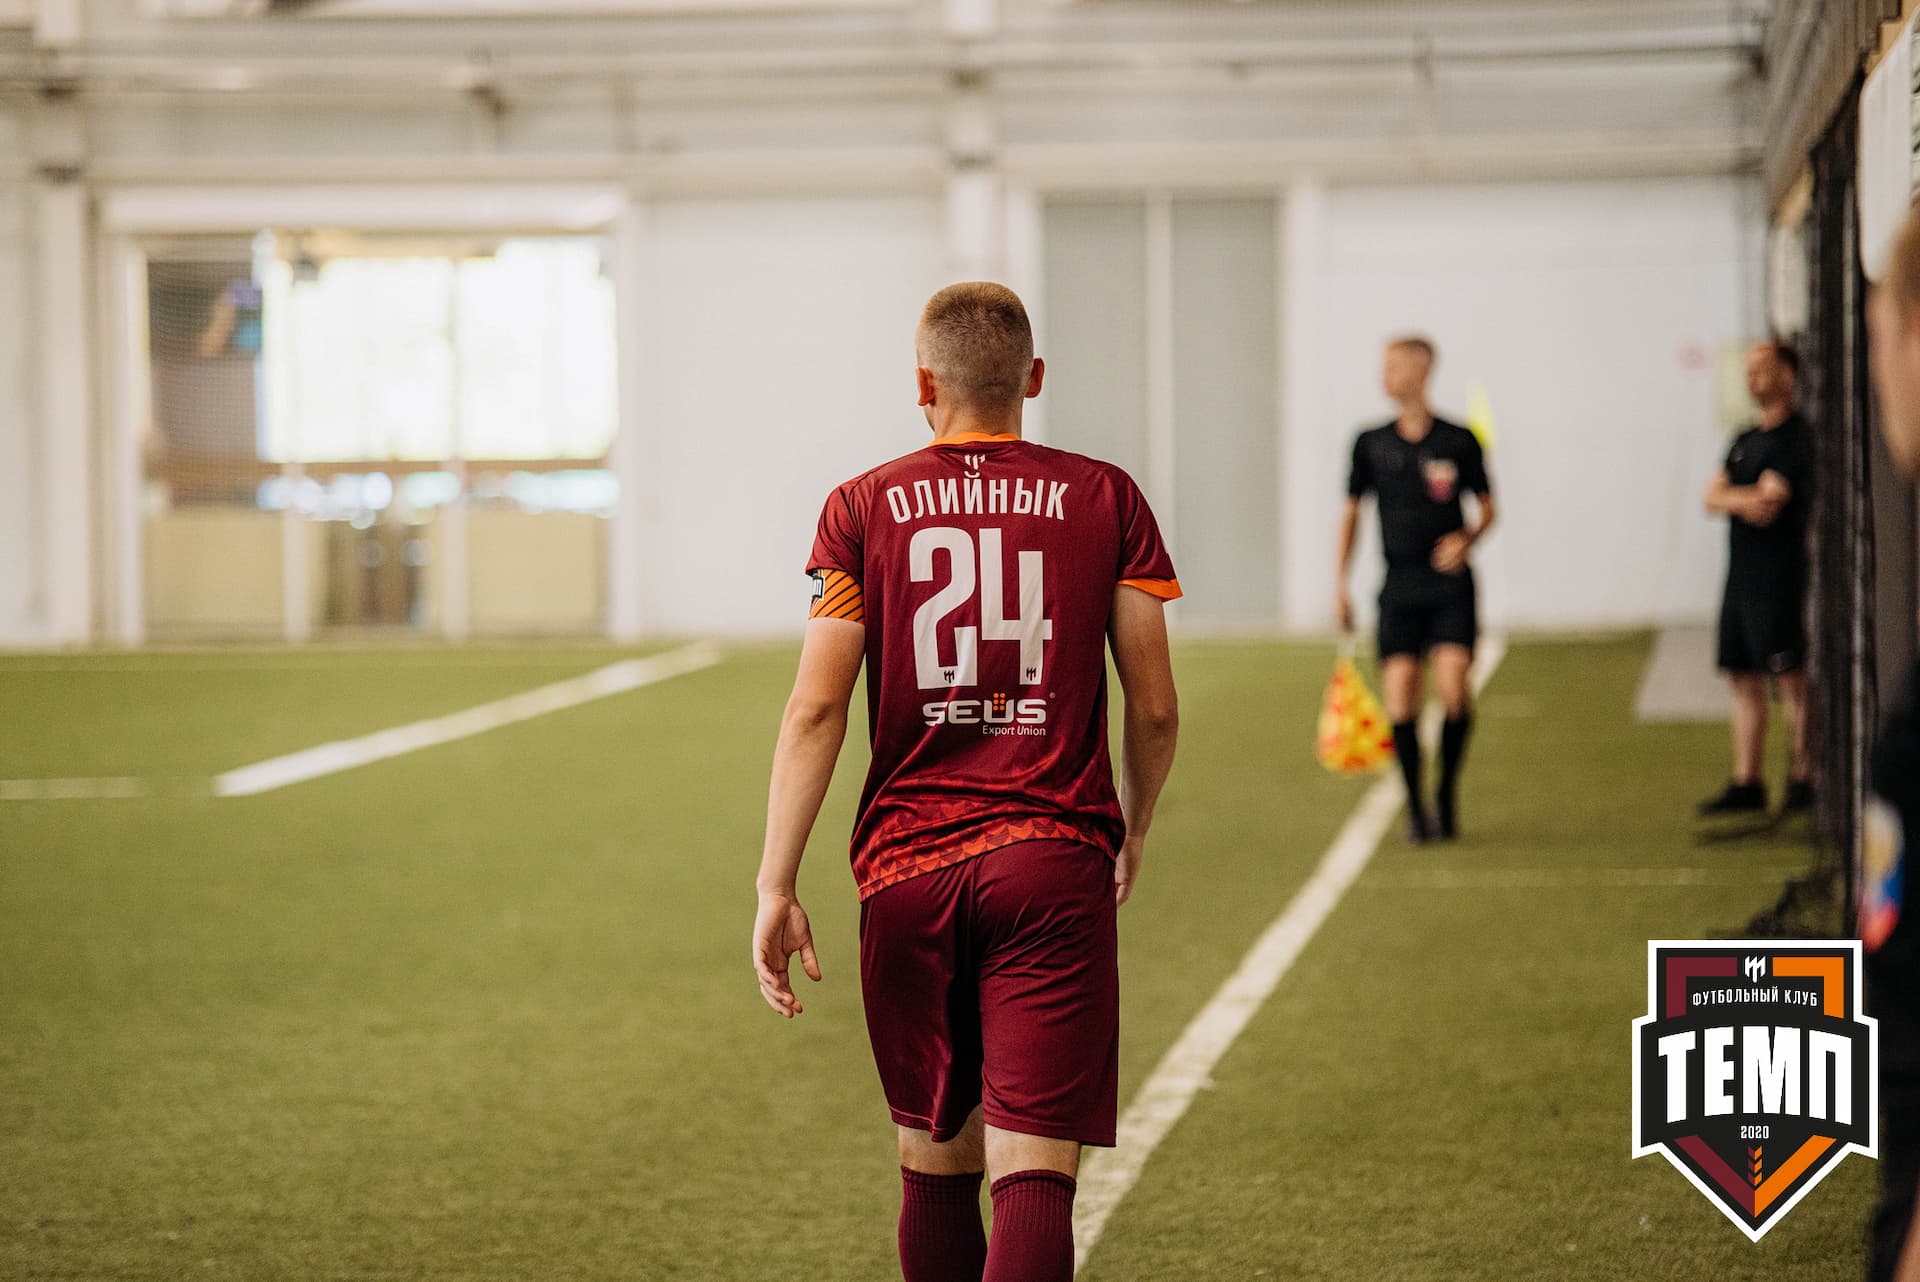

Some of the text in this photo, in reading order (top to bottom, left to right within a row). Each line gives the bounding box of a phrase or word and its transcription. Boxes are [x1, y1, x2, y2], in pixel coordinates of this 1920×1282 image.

[886, 470, 1069, 524] ОЛИЙНЫК
[909, 526, 1053, 690] 24
[982, 725, 1046, 736] Export Union
